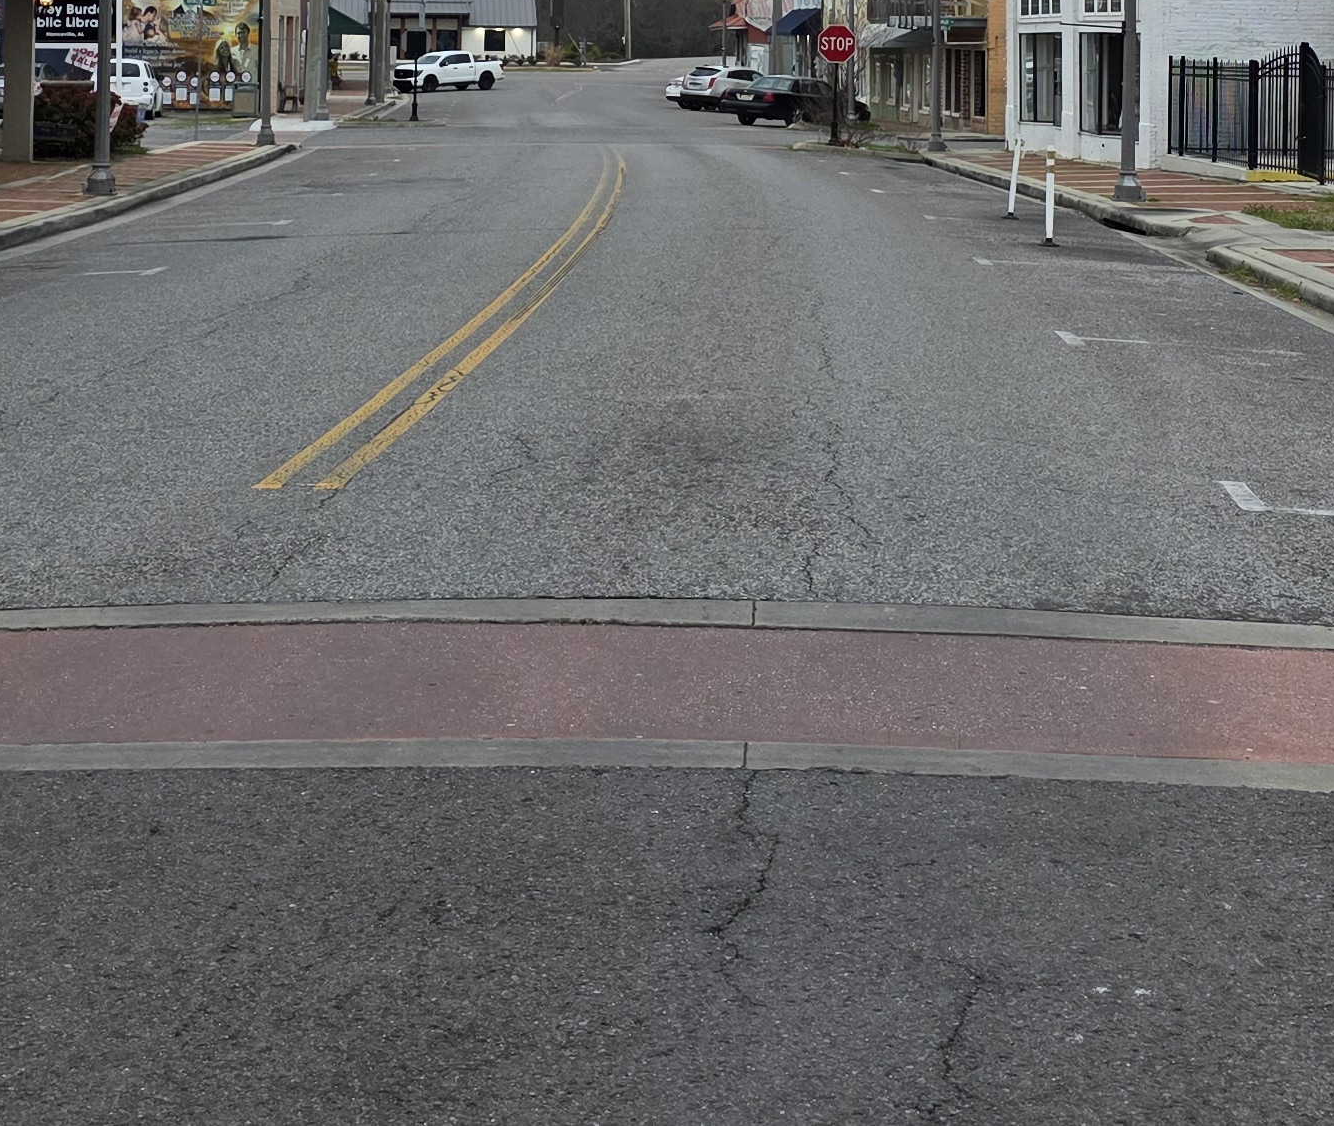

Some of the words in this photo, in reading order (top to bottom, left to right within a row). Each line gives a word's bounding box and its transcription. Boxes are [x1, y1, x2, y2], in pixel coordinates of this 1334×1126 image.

[66, 3, 100, 15] Burd
[36, 16, 62, 28] blic
[65, 16, 99, 28] Libra
[820, 36, 854, 52] STOP
